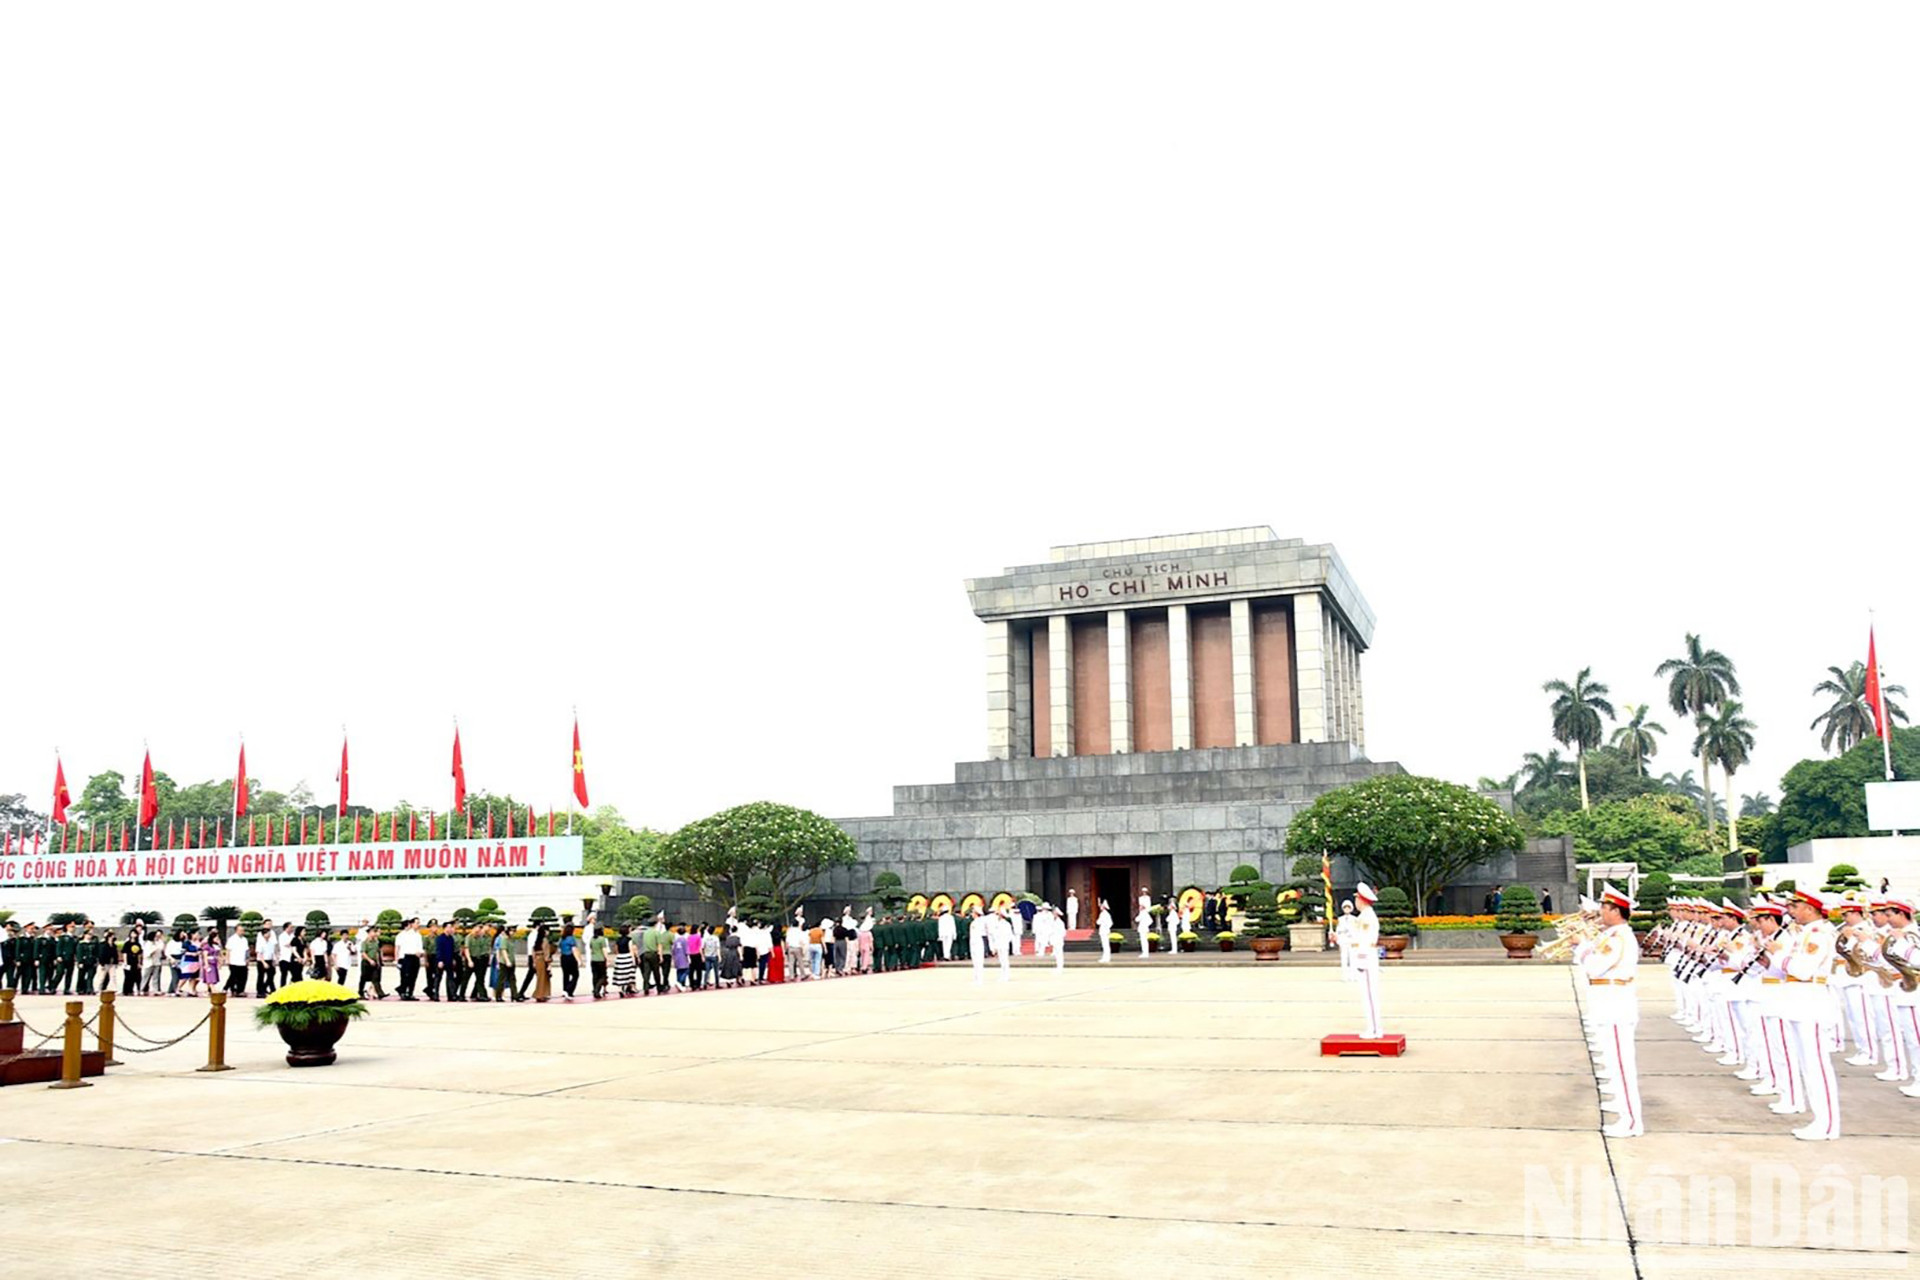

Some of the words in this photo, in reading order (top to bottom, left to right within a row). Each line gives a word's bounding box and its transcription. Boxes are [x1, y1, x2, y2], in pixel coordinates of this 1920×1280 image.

[23, 857, 67, 882] CỘNG
[116, 854, 137, 876] XÃ
[145, 853, 175, 879] HỘI
[183, 849, 220, 875] CHỦ
[227, 849, 286, 874] NGHĨA
[296, 847, 339, 875] VIỆT
[348, 849, 394, 870] NAM
[404, 843, 467, 869] MUÔN
[477, 841, 528, 868] NĂM
[539, 844, 546, 867] !
